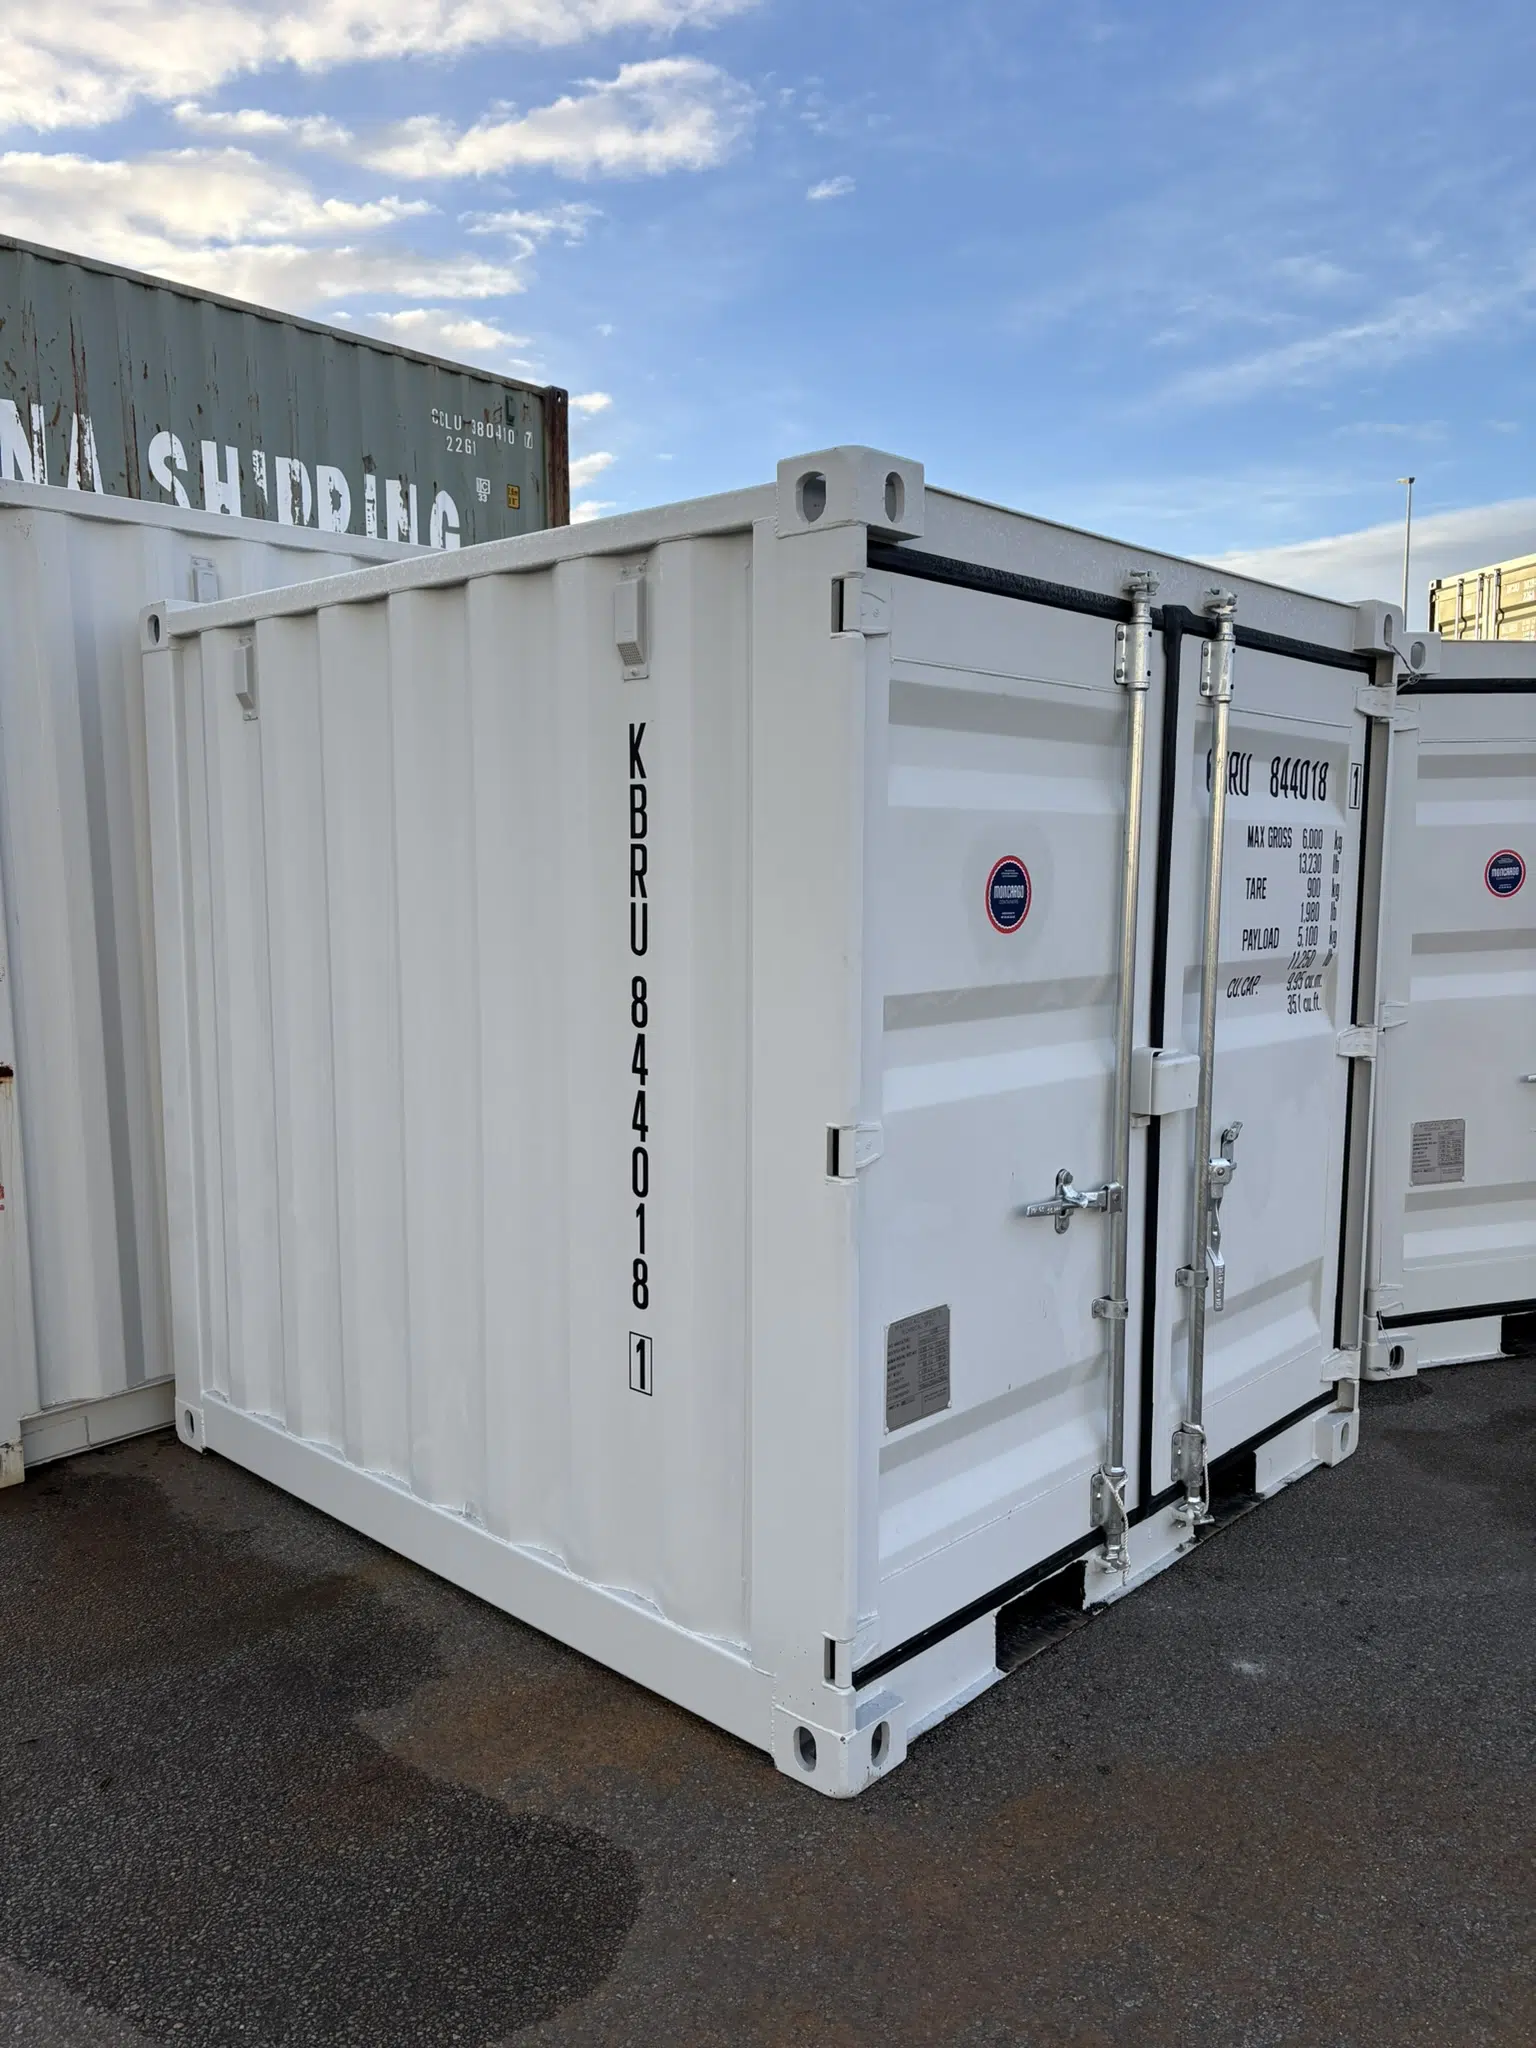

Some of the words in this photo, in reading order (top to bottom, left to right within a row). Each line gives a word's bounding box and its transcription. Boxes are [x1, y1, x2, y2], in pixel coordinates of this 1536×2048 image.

[471, 418, 515, 445] 380410
[446, 435, 476, 456] 22G1
[1207, 749, 1252, 796] RU
[1270, 756, 1329, 801] 844018
[629, 722, 648, 956] KBRU
[1247, 825, 1265, 848] MAX
[1268, 826, 1292, 848] GROSS
[1334, 829, 1342, 855] kg
[1333, 854, 1339, 874] lb
[1246, 877, 1267, 900] TARE
[1307, 877, 1321, 898] 900
[1331, 878, 1340, 902] kg
[1330, 901, 1337, 921] lb
[1242, 927, 1280, 951] PAYLOAD
[1329, 924, 1337, 949] kg
[631, 975, 649, 1310] 844018
